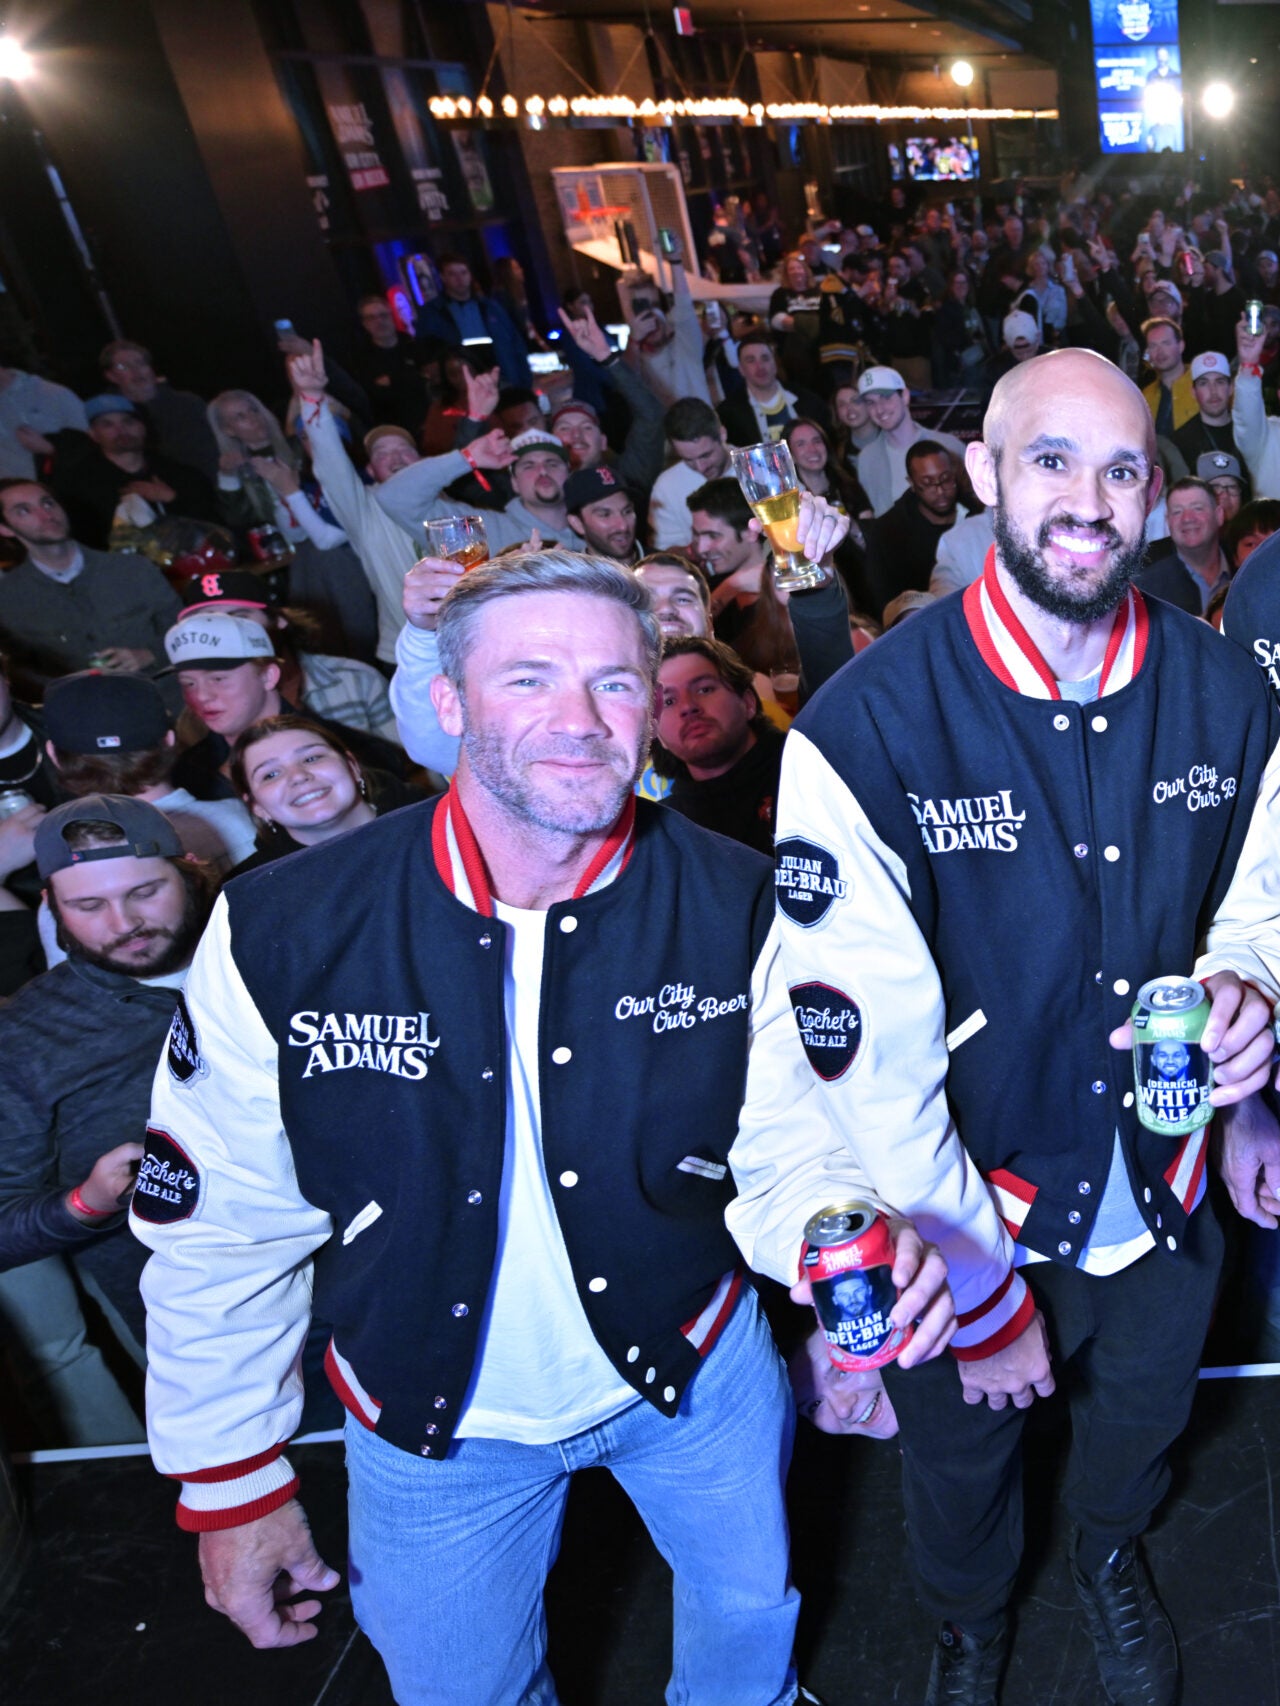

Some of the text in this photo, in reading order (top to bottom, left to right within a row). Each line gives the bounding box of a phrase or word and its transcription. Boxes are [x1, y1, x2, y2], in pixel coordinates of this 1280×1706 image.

[1153, 777, 1187, 804] Our
[1187, 789, 1221, 812] Our
[921, 822, 1019, 853] ADAMS
[780, 855, 823, 875] JULIAN
[775, 869, 848, 899] DEL-BRAU
[788, 889, 813, 901] LAGER
[615, 995, 656, 1020] Our
[288, 1011, 441, 1048] SAMUEL
[653, 1009, 697, 1033] Our
[804, 1033, 848, 1047] PALE ALE
[302, 1042, 429, 1080] ADAMS
[1138, 1085, 1210, 1108] WHITE
[1156, 1107, 1189, 1121] ALE
[141, 1153, 196, 1190] rochet's
[136, 1178, 182, 1204] PALE ALE
[824, 1317, 894, 1346] EDEL-BRA
[836, 1310, 883, 1332] JULIAN
[851, 1338, 880, 1352] LAGER
